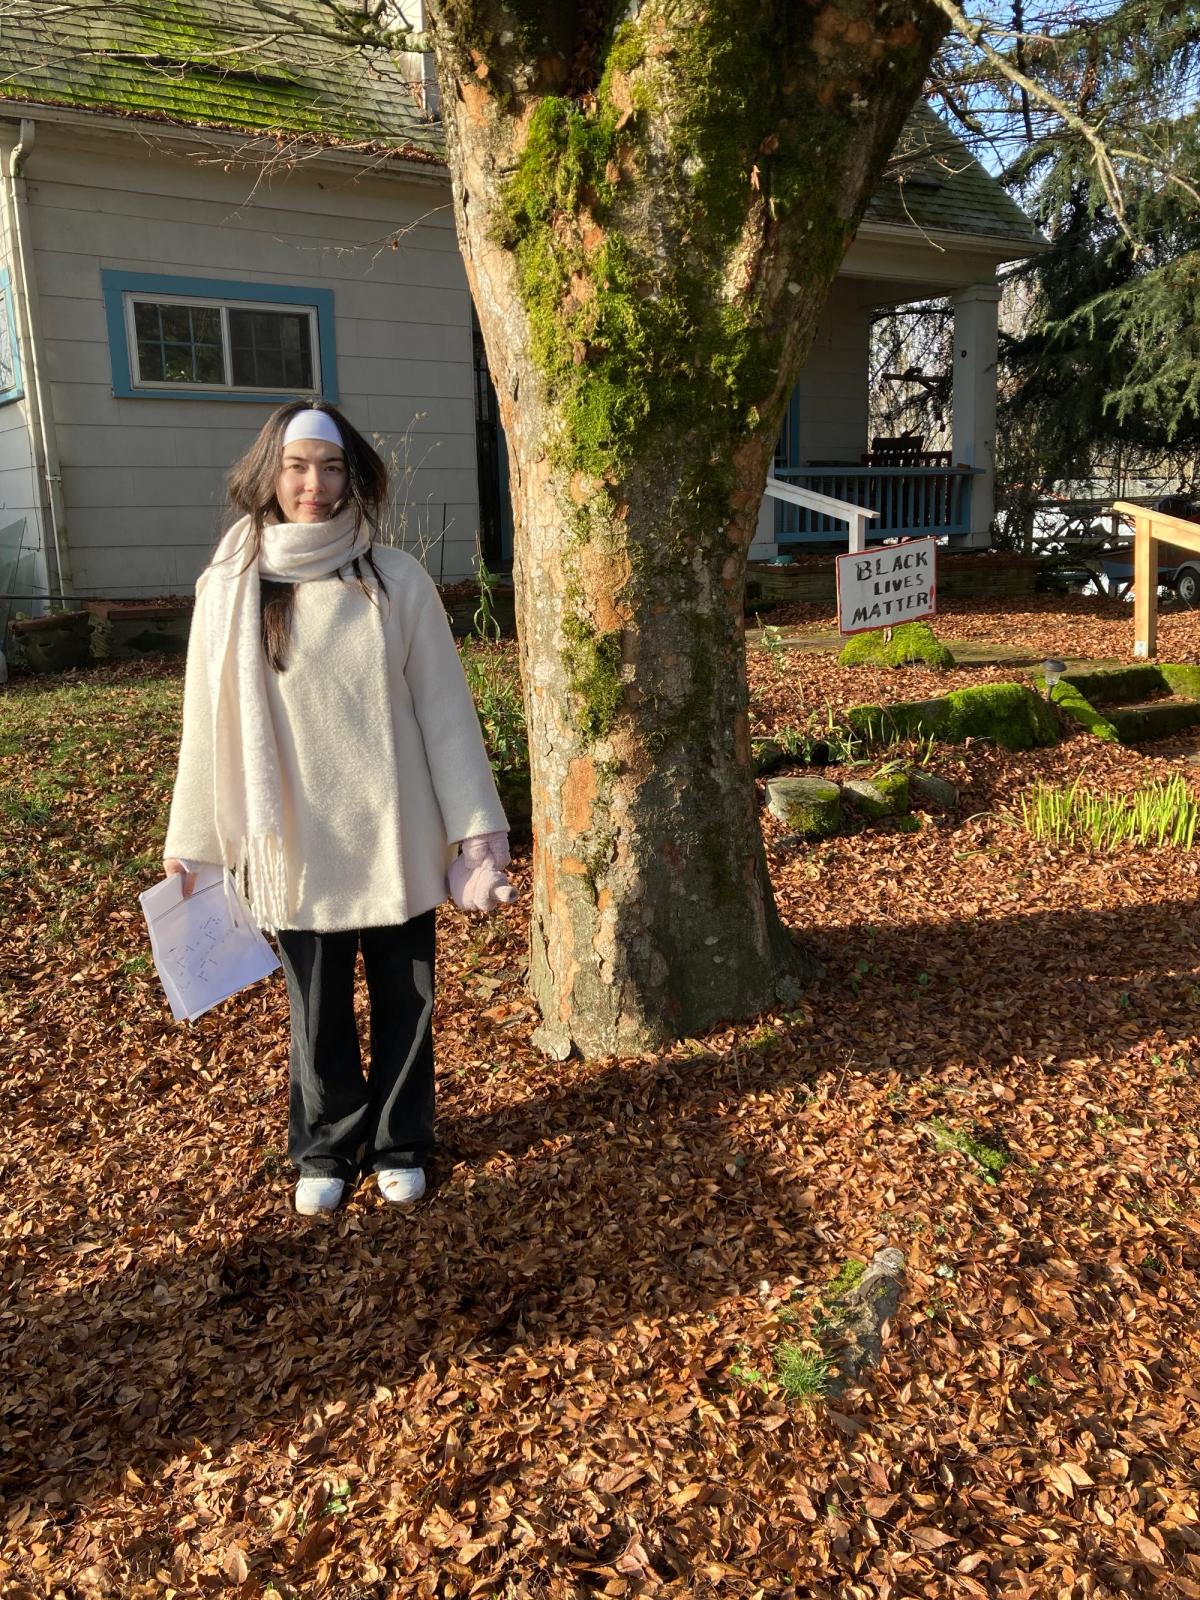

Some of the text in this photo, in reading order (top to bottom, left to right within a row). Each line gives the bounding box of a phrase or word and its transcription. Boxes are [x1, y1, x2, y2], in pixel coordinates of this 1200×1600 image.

[855, 552, 928, 581] BLACK
[874, 574, 924, 595] LIVES
[851, 585, 935, 625] MATTER!
